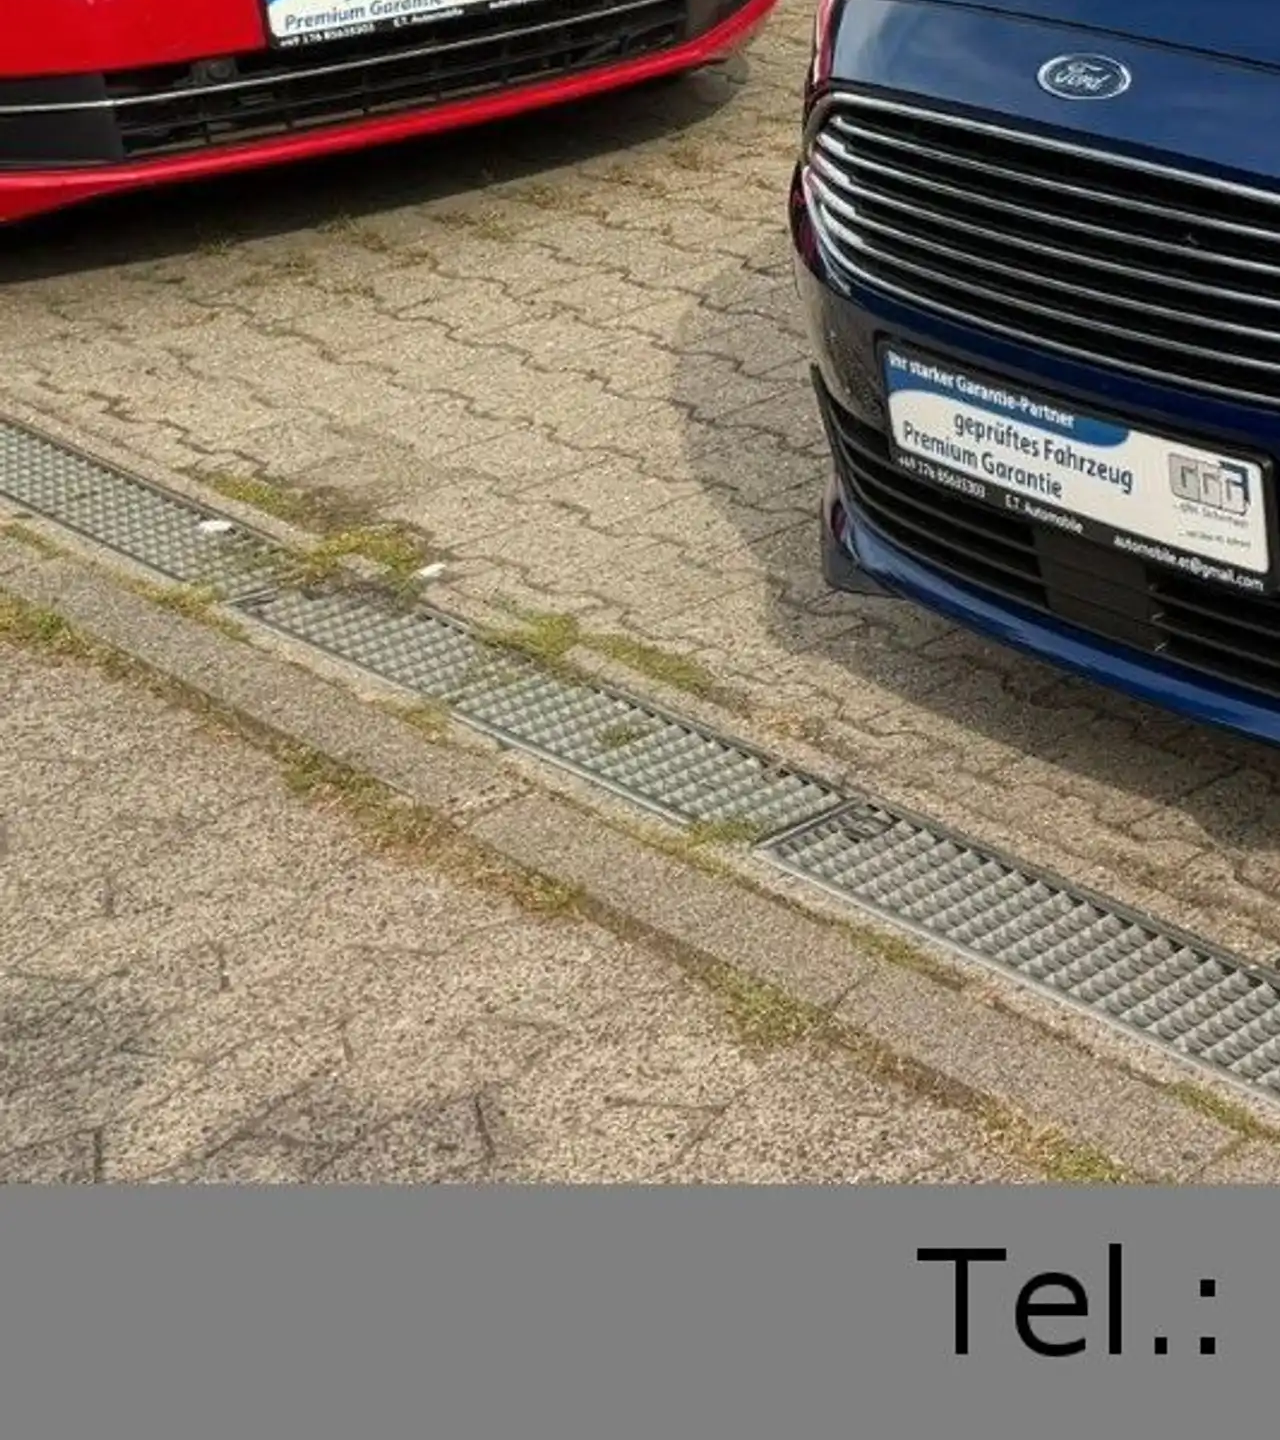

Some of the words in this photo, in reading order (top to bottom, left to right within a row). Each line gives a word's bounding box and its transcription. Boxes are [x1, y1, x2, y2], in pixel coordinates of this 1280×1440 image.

[284, 2, 367, 31] Premium
[909, 358, 955, 389] starker
[955, 374, 1075, 430] Garantie-Partner
[903, 419, 979, 469] Premium
[980, 450, 1063, 499] Garantie
[953, 413, 1041, 458] geprüftes
[1043, 438, 1134, 495] Fahrzeug
